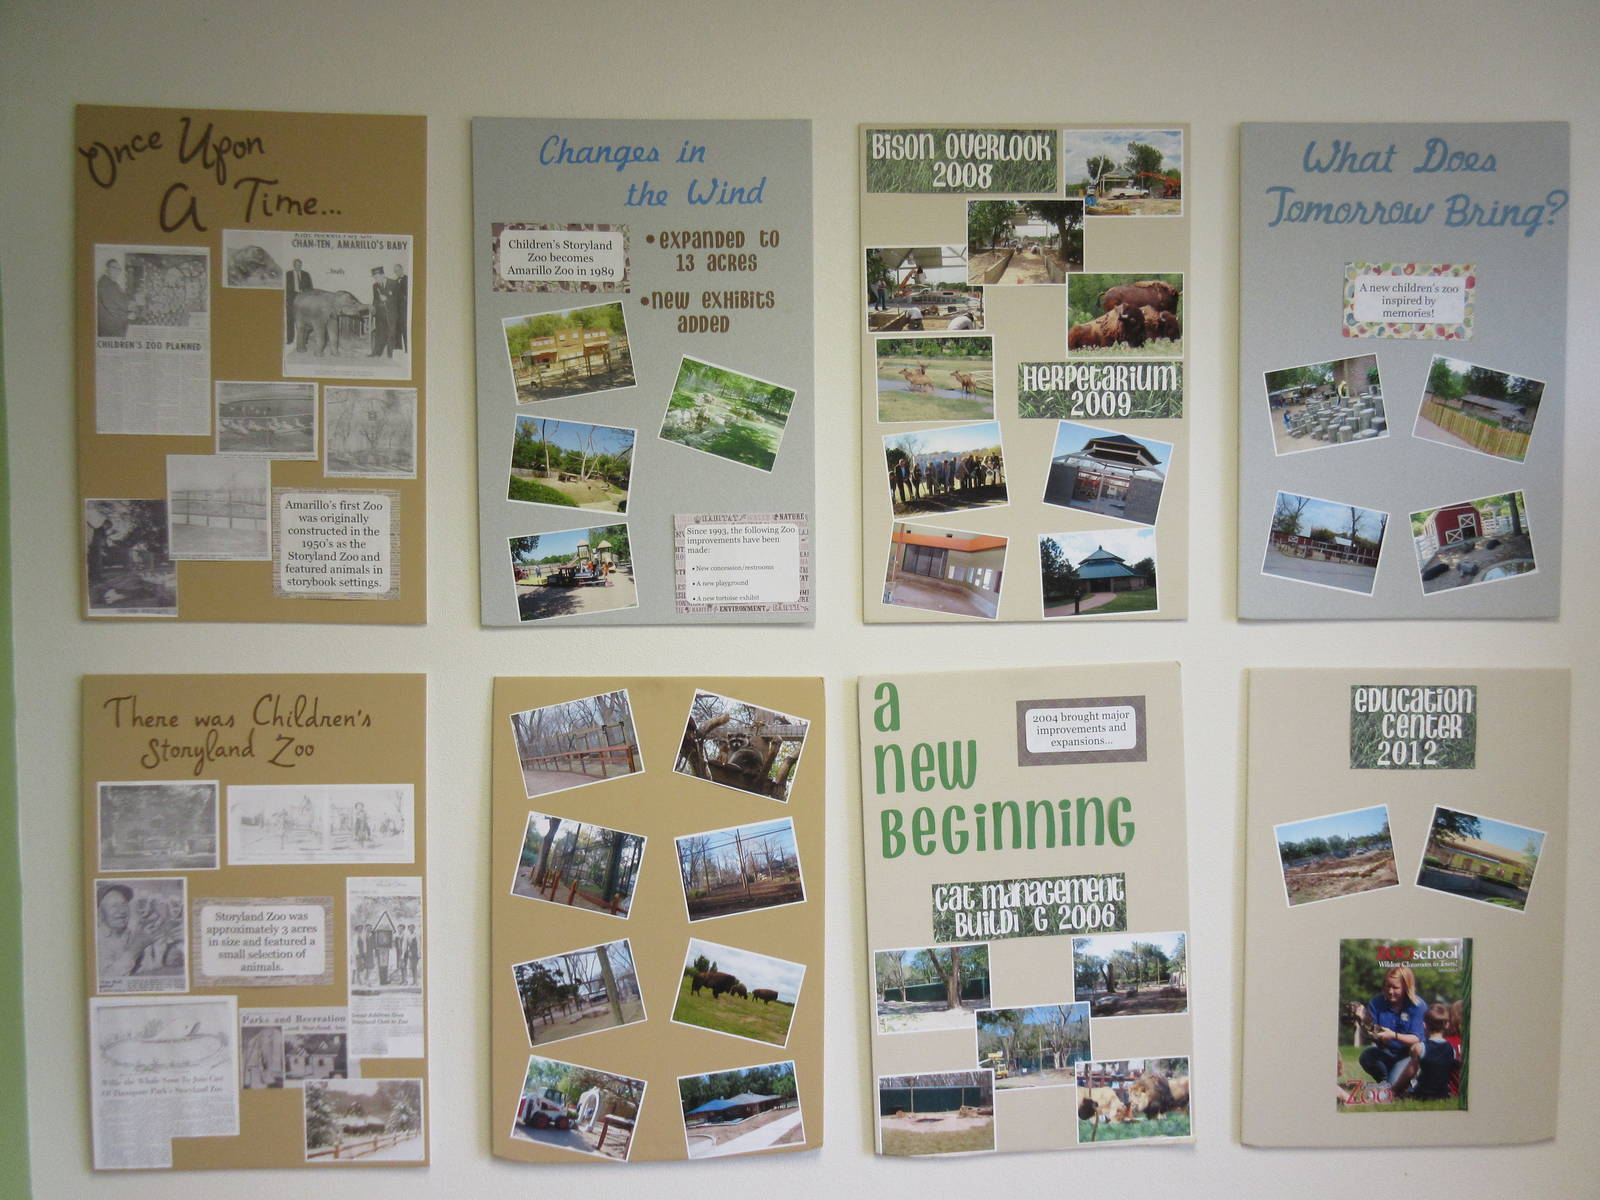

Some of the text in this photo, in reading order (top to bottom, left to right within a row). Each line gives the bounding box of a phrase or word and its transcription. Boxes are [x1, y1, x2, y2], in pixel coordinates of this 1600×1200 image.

[80, 117, 265, 189] Once Upon
[539, 135, 706, 172] Changes in
[1302, 138, 1497, 173] What Does
[932, 162, 993, 188] 2008
[624, 176, 767, 207] the Wind
[233, 177, 342, 223] Time...
[1265, 186, 1569, 237] Tomorrow Bring?
[337, 240, 384, 250] AMARILLO'S
[508, 239, 612, 252] Children's Storyland
[527, 252, 594, 263] Zoo becomes
[676, 253, 695, 272] 13
[507, 265, 614, 277] Amarillo Zoo in 1989
[1360, 283, 1367, 292] A
[1370, 284, 1389, 292] new
[1392, 283, 1439, 293] children's
[1382, 296, 1436, 307] inspired by
[1383, 309, 1434, 318] memories!
[145, 341, 162, 350] ZOO
[166, 342, 202, 351] PLANNED
[1071, 391, 1132, 416] 2009
[285, 500, 383, 511] Amarillo's first Zoo
[299, 513, 369, 525] was originally
[288, 526, 380, 536] constructed in the
[687, 527, 708, 535] Since
[731, 526, 743, 534] the
[744, 526, 779, 536] following
[780, 525, 796, 534] Zoo
[302, 538, 333, 549] 1950's
[350, 539, 366, 548] the
[687, 535, 780, 547] improvements have been
[687, 546, 711, 554] made:
[288, 551, 380, 563] Storyland Zoo and
[285, 563, 383, 574] featured animals in
[287, 577, 382, 589] storybook settings.
[715, 579, 749, 588] playground
[103, 693, 372, 728] There was Children's
[1033, 709, 1130, 723] 2004 brought major
[1037, 722, 1127, 736] improvements and
[141, 728, 315, 776] Storyland Zoo
[1377, 741, 1437, 765] 2012
[215, 911, 308, 923] Storyland Zoo was
[1058, 903, 1115, 930] 2006
[207, 924, 317, 936] approximately 3 acres
[209, 937, 218, 946] in
[221, 937, 240, 946] size
[243, 937, 261, 946] and
[264, 936, 306, 946] featured
[218, 948, 306, 959] small selection of
